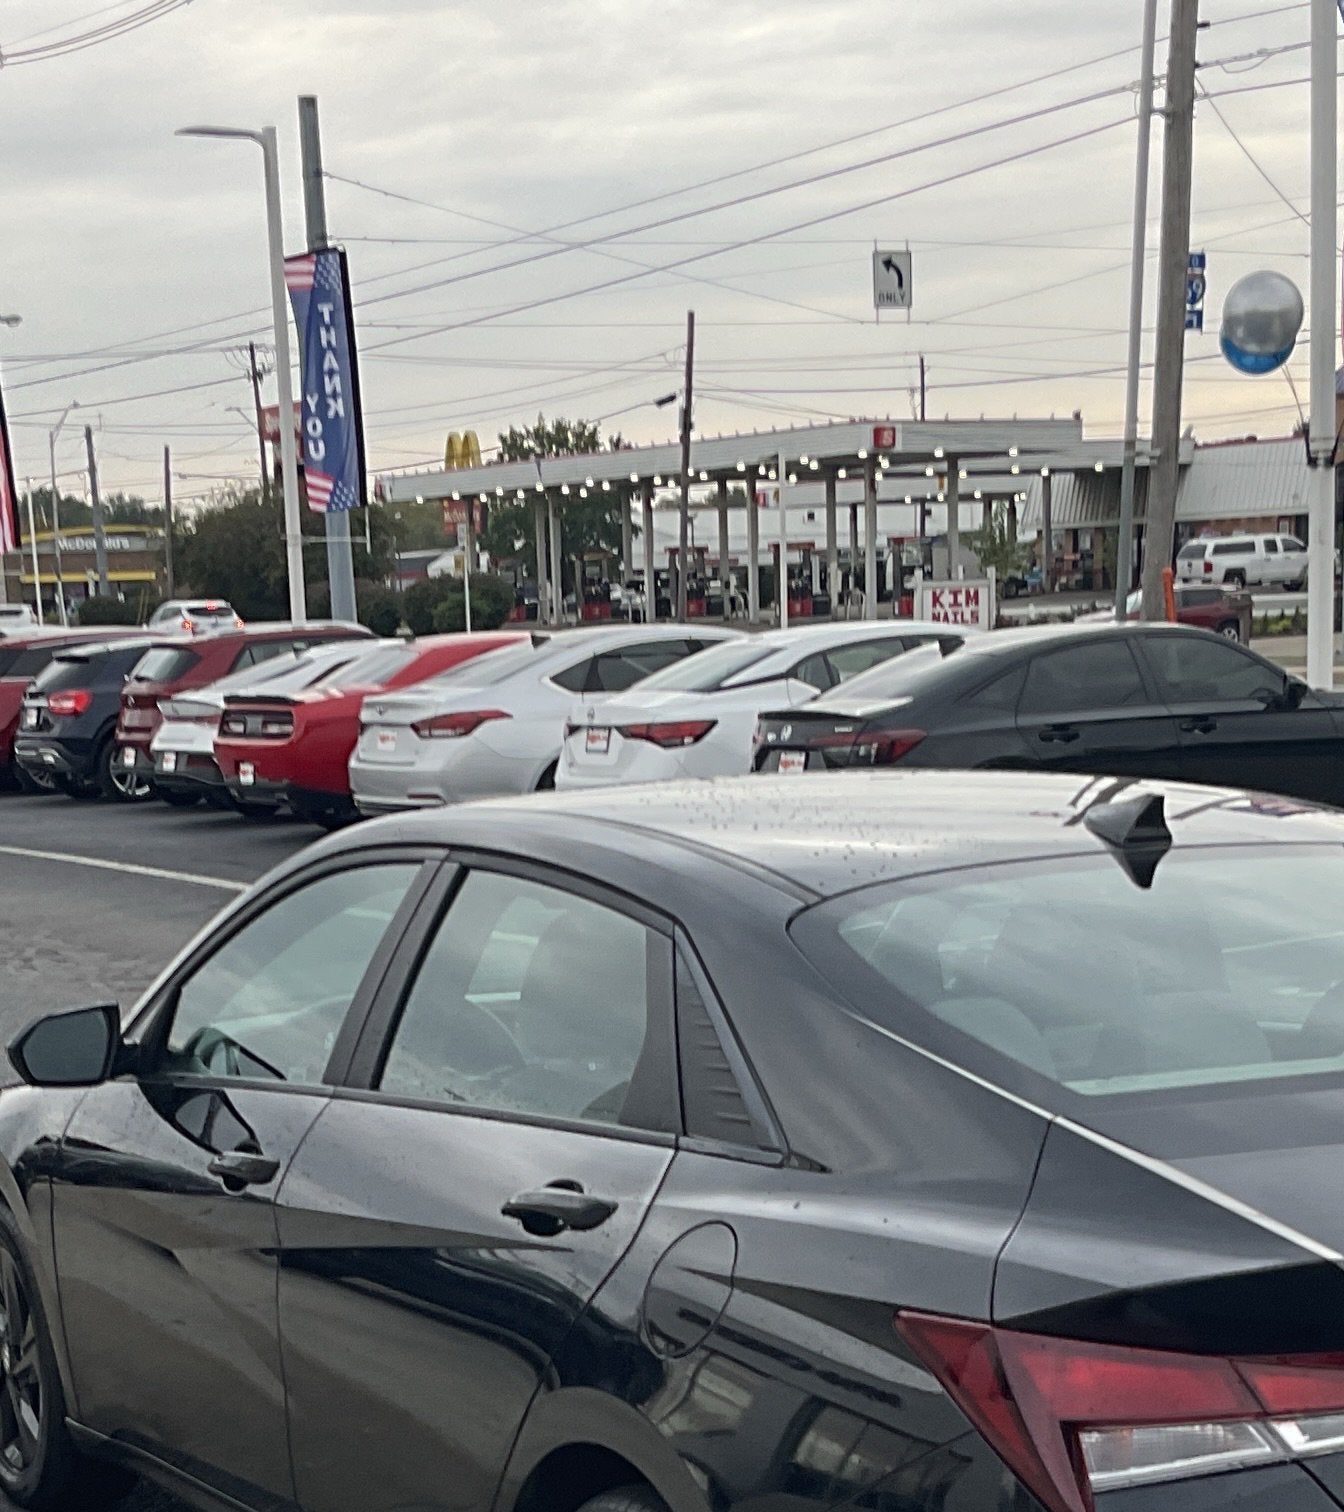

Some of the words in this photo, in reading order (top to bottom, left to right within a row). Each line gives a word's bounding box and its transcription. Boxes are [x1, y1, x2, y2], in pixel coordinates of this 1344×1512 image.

[878, 291, 906, 303] ONLY
[932, 588, 979, 609] KIM
[932, 610, 979, 624] NAILS
